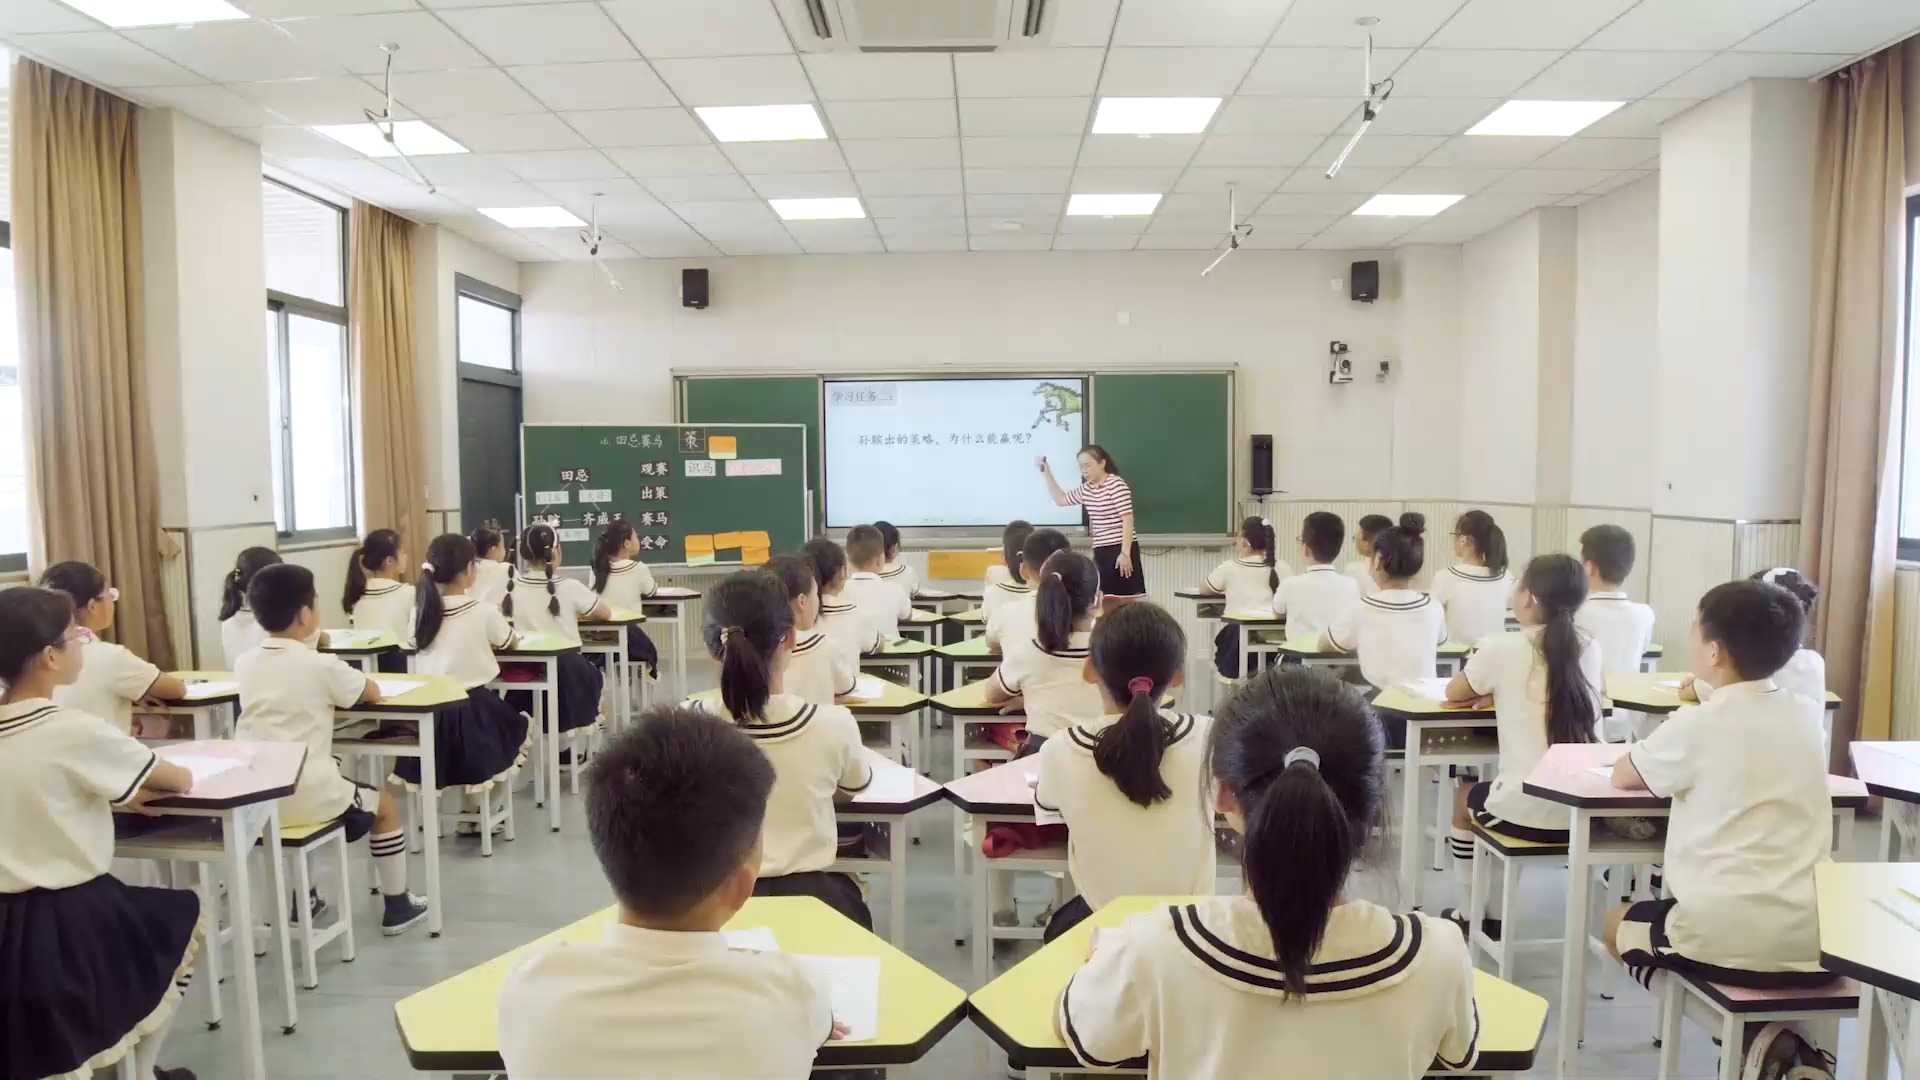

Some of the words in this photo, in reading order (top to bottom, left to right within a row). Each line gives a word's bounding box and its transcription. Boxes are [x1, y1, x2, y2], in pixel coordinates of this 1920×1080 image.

[560, 468, 589, 482] 田忌
[641, 461, 669, 476] 观赛
[641, 486, 669, 500] 出策
[641, 511, 668, 527] 赛马
[640, 535, 668, 550] 受命
